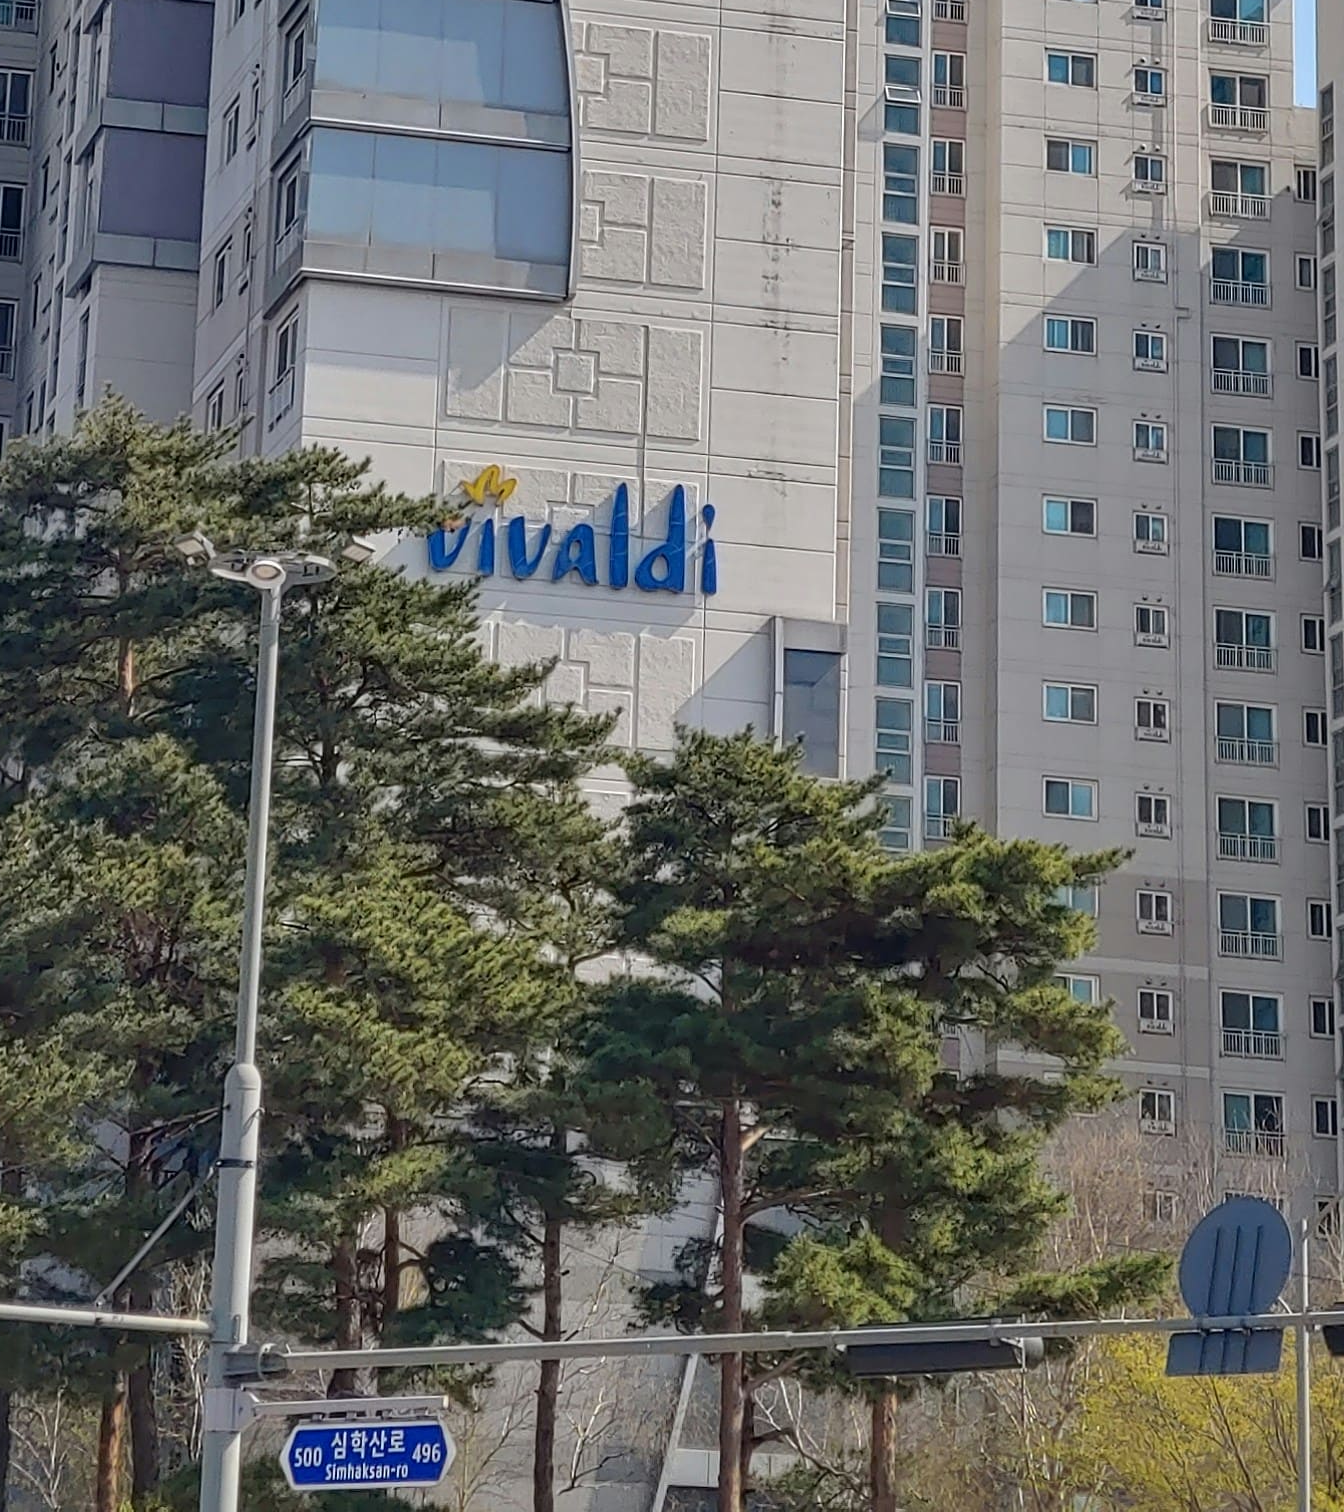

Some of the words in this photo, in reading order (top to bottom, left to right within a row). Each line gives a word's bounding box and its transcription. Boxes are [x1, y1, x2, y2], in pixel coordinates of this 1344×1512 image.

[425, 480, 717, 596] vivaldi
[294, 1446, 323, 1468] 500
[331, 1429, 406, 1460] 심학산로
[412, 1443, 442, 1464] 496
[325, 1462, 409, 1481] Simhaksan-ro
